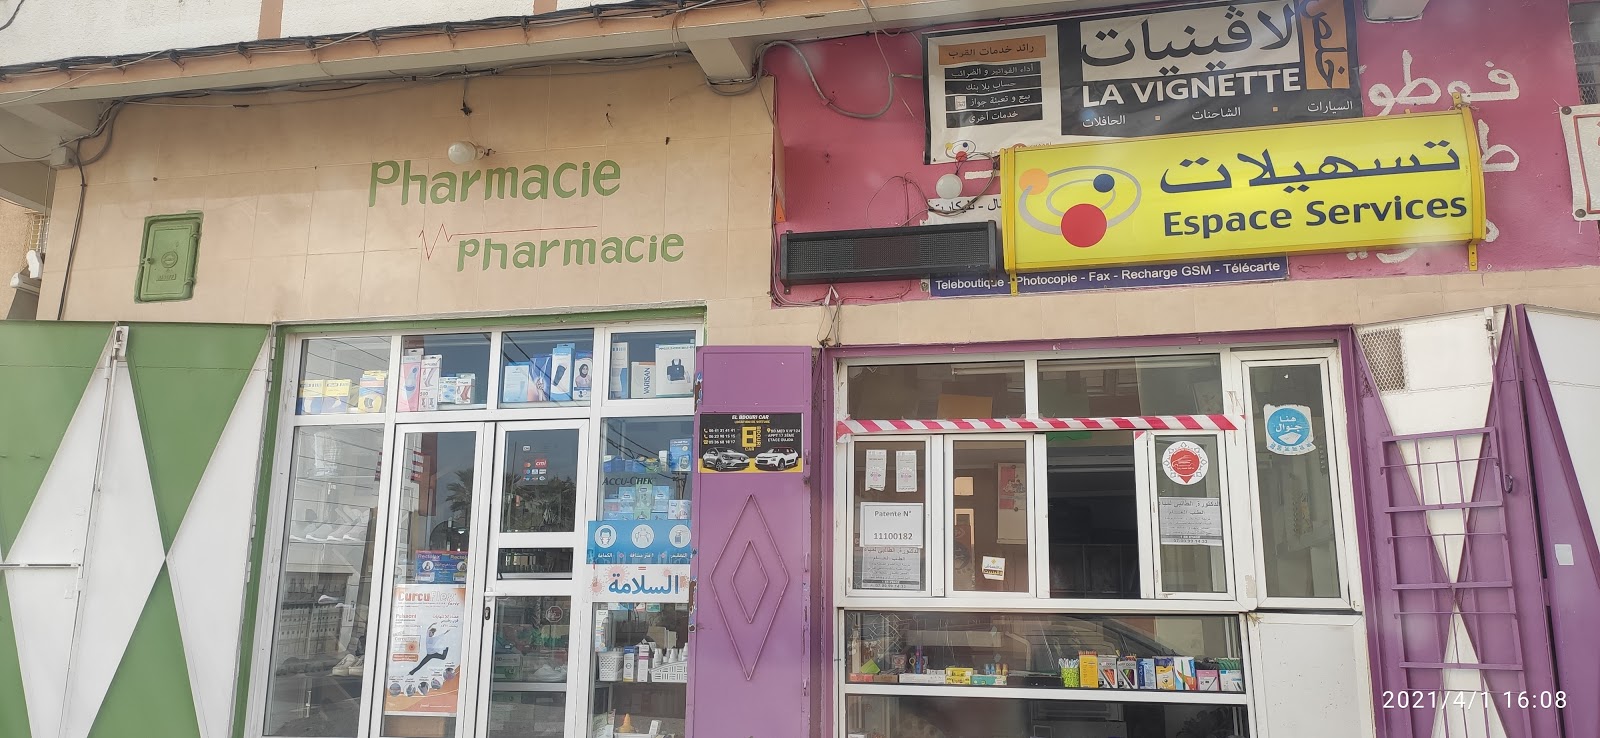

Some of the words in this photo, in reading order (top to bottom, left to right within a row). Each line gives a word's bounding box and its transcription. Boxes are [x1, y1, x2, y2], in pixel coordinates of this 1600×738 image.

[948, 48, 976, 59] القرب
[979, 45, 1013, 56] خدمات
[1016, 43, 1034, 53] رائد
[951, 68, 981, 79] الضرائب
[965, 83, 979, 92] بنك
[981, 82, 990, 91] بلا
[992, 80, 1017, 89] حساب
[1082, 83, 1125, 108] LA
[1131, 67, 1301, 103] VIGNETTE
[970, 98, 987, 108] جواز
[1018, 94, 1031, 104] بيع
[1307, 101, 1354, 114] السيارات
[968, 112, 989, 124] أخرى
[991, 110, 1019, 120] خدمات
[1191, 107, 1242, 121] الشاحنات
[1082, 115, 1127, 128] الحافلات
[1159, 139, 1461, 194] تسهيلات
[368, 159, 622, 208] Pharmacie
[1163, 208, 1293, 239] Espace
[1305, 195, 1468, 227] Services
[935, 278, 1005, 290] Teleboutique
[1016, 273, 1078, 287] Photocopie
[1088, 271, 1110, 282] Fax
[1121, 268, 1178, 281] Recharge
[1181, 265, 1212, 277] GSM
[1223, 261, 1281, 274] Télécarte
[1275, 423, 1302, 432] جوال
[602, 476, 654, 486] ACCU-CHEK
[873, 532, 913, 540] 11100182
[608, 574, 679, 594] السلامة
